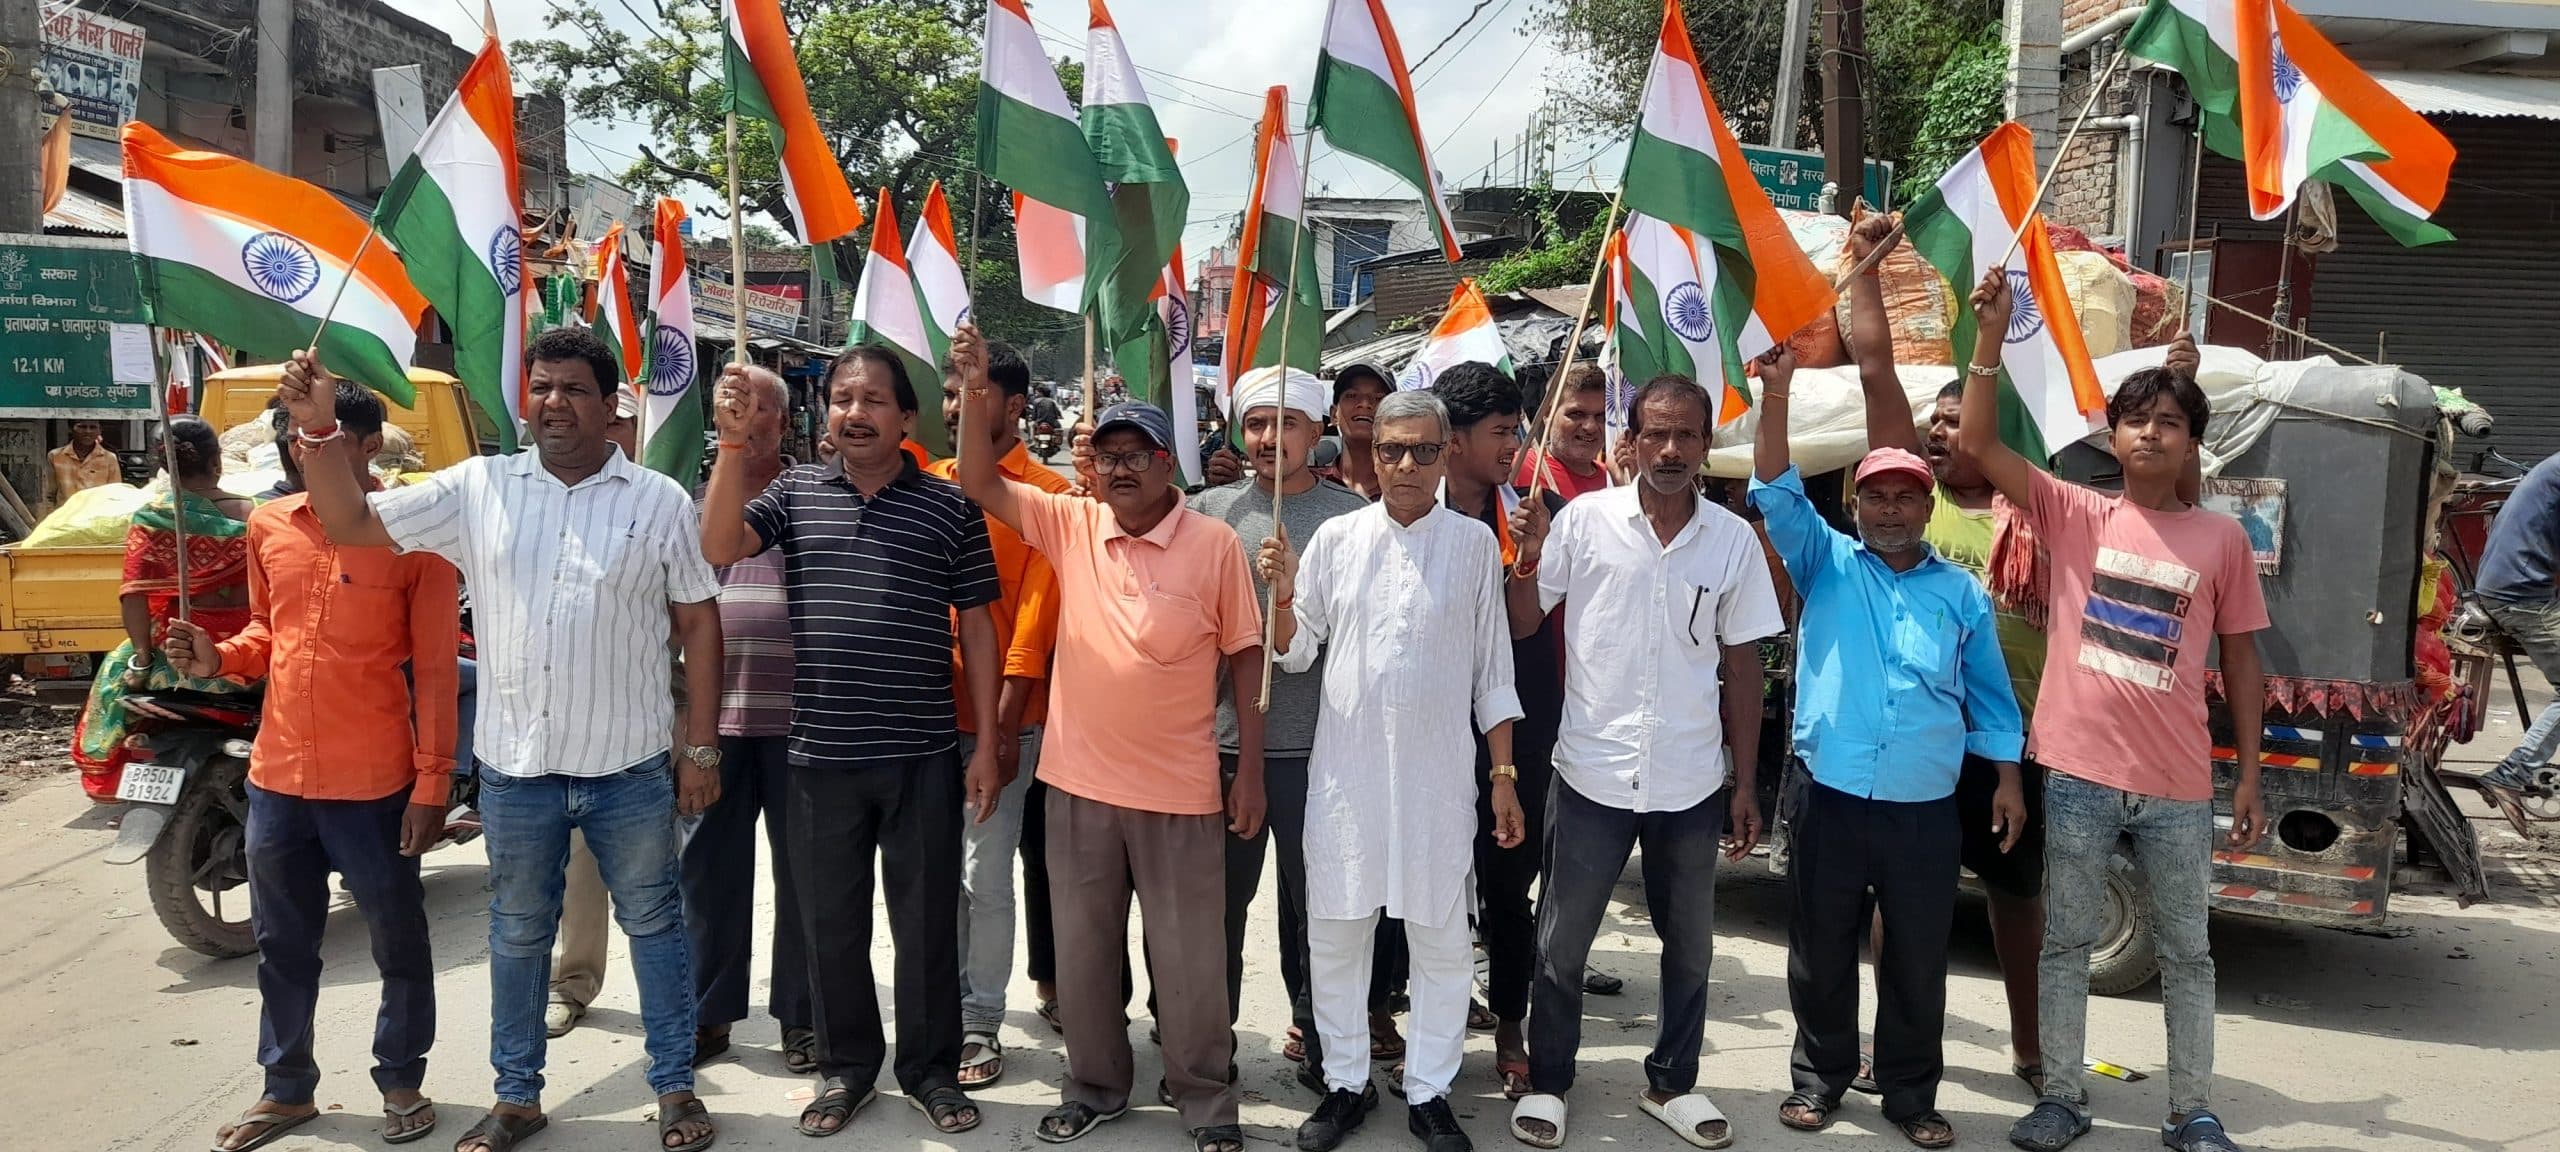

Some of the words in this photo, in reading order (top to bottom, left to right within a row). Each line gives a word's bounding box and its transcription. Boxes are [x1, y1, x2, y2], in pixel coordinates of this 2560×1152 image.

[40, 268, 78, 281] सरकार
[32, 293, 77, 307] विभाग
[704, 283, 735, 301] मोबाई
[4, 313, 50, 334] प्रतापगंज
[62, 318, 97, 342] छातापुर
[12, 358, 39, 373] 12.1
[44, 358, 65, 374] KM
[131, 767, 174, 785] BR50A
